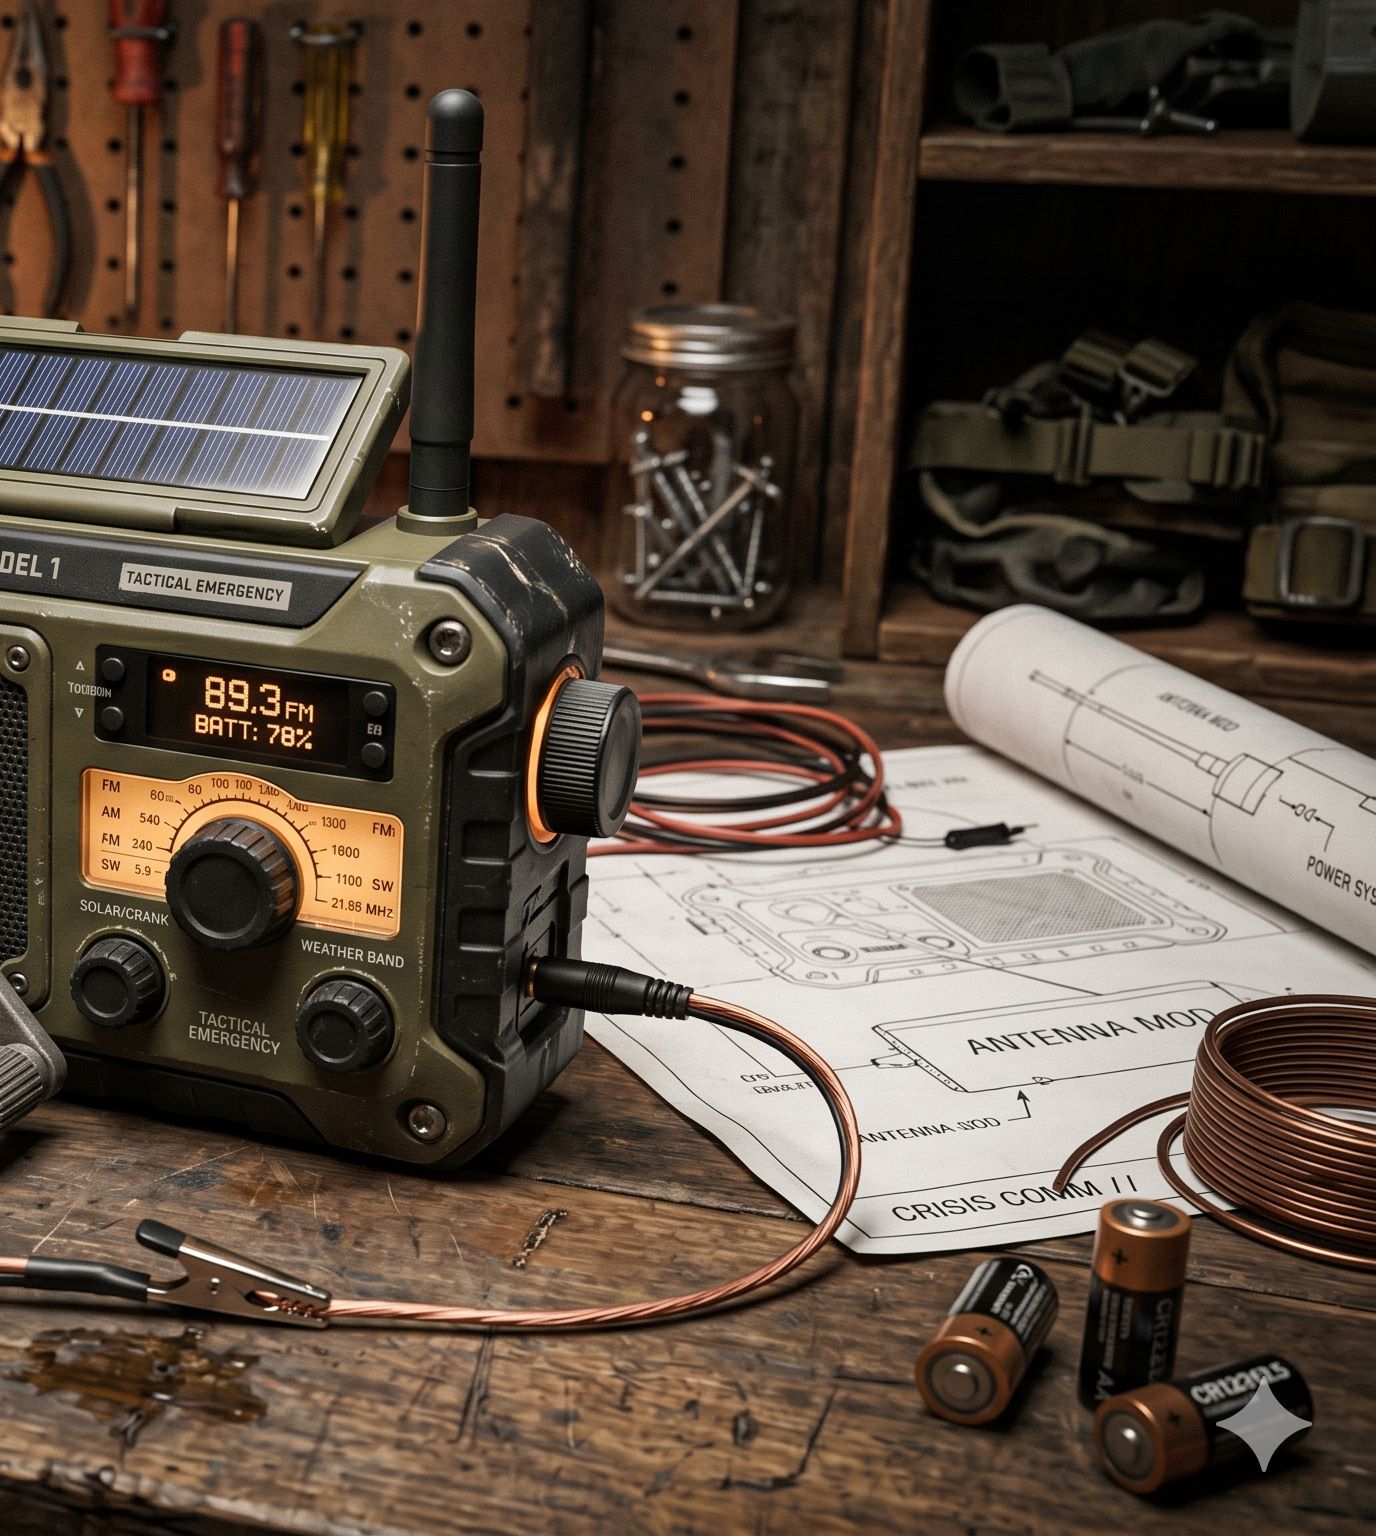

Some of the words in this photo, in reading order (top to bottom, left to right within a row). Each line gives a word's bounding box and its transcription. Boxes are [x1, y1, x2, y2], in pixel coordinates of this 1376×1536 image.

[50, 556, 60, 580] 1
[126, 570, 192, 592] TACTICAL
[196, 578, 285, 603] EMERGENCY
[205, 676, 281, 717] 89.3
[285, 701, 314, 723] FM
[195, 713, 258, 741] BATT:
[267, 723, 313, 750] 78%
[102, 779, 120, 793] FM
[211, 777, 230, 789] 100
[235, 779, 253, 791] 100
[101, 805, 120, 820] AM
[139, 812, 160, 826] 540
[322, 816, 346, 830] 1300
[101, 832, 120, 846] FM
[132, 838, 153, 851] 240
[101, 858, 121, 871] SW
[134, 864, 151, 876] 5.9
[336, 873, 362, 888] 1100
[1306, 855, 1352, 893] POWER
[372, 879, 394, 893] SW
[80, 899, 169, 926] SOLAR/CRANK
[366, 903, 395, 918] MHz
[301, 939, 364, 962] WEATHER
[367, 951, 405, 969] BAND
[198, 1011, 270, 1038] TACTICAL
[189, 1025, 281, 1056] EMERGENCY
[966, 1020, 1138, 1055] ANTENNA
[892, 1195, 996, 1222] CRISIS
